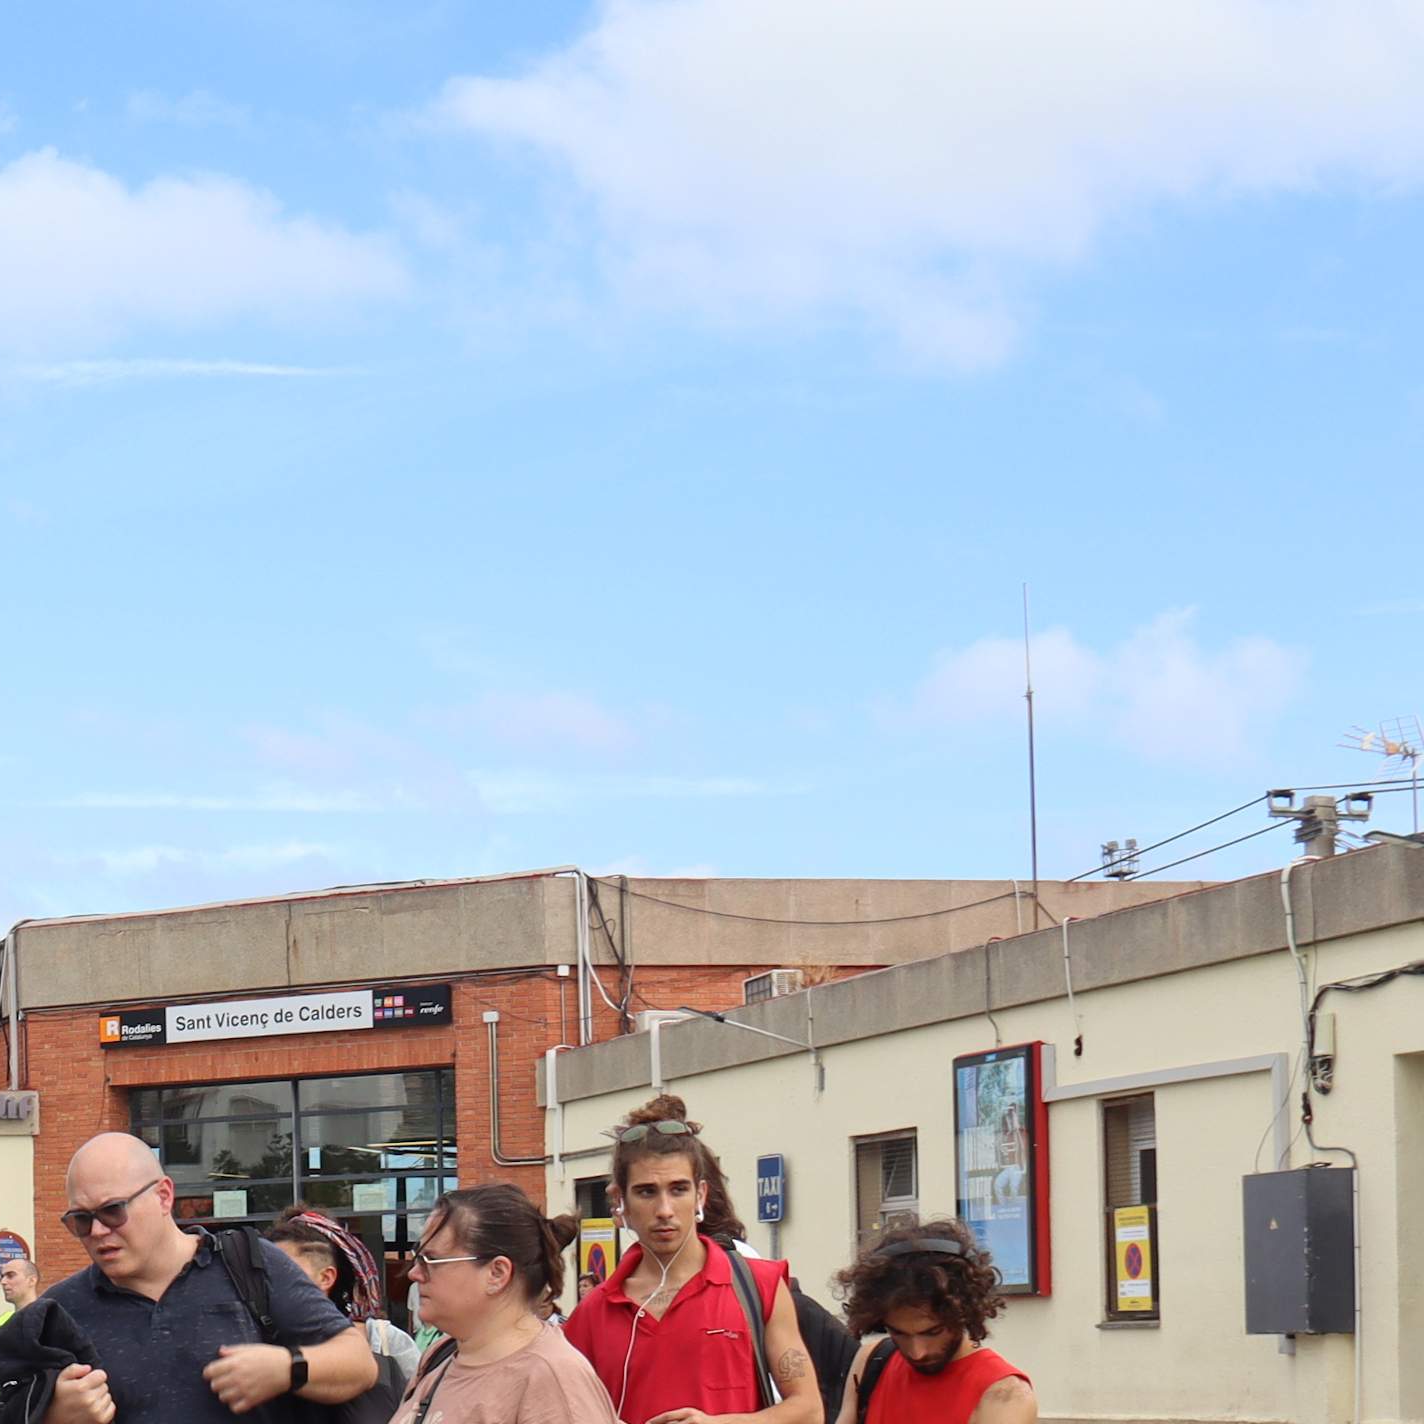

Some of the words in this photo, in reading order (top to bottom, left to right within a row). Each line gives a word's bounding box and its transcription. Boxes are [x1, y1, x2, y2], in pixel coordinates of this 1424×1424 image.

[175, 1013, 212, 1032] Sant
[214, 1010, 270, 1030] Vicenç
[273, 1008, 295, 1024] de
[298, 1004, 363, 1022] Calders
[419, 1004, 444, 1015] renfe
[105, 1020, 119, 1037] R
[121, 1022, 162, 1035] Rodalies
[758, 1176, 783, 1197] TAXI
